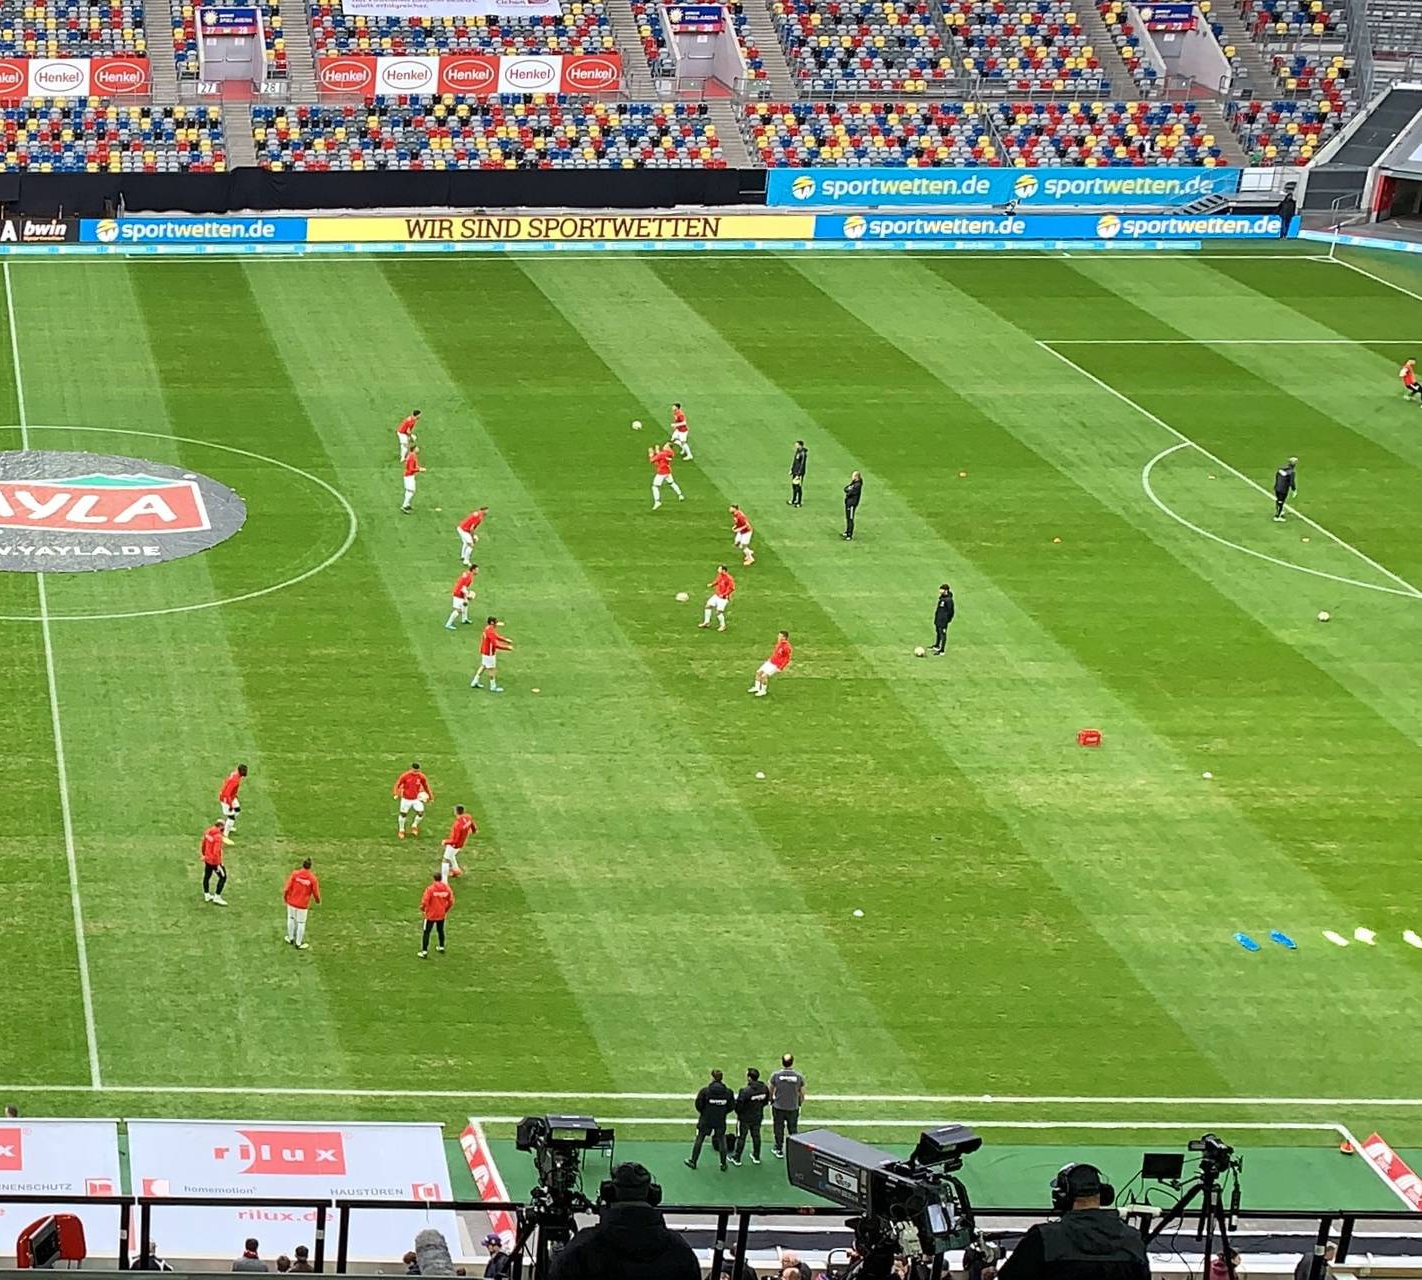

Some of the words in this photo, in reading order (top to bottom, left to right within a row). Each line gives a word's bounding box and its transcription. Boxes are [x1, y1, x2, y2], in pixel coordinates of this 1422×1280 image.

[38, 72, 79, 83] Henkel
[99, 71, 140, 83] Henkel
[324, 70, 367, 81] Henkel
[386, 70, 428, 81] Henkel
[448, 69, 489, 81] Henkel
[509, 69, 550, 80] Henkel
[571, 68, 612, 80] Henkel
[264, 82, 276, 93] 28
[822, 175, 991, 199] sportwetten.de
[1044, 174, 1215, 199] sportwetten.de
[23, 219, 68, 236] bwin
[121, 221, 276, 242] sportwetten.de
[405, 218, 453, 239] WIR
[460, 218, 521, 239] SIND
[527, 217, 722, 239] SPORTWETTEN
[869, 217, 1026, 238] sportwetten.de
[1122, 216, 1282, 238] sportwetten.de
[213, 1144, 338, 1162] rilux
[329, 1185, 404, 1196] HAUSTÜREN
